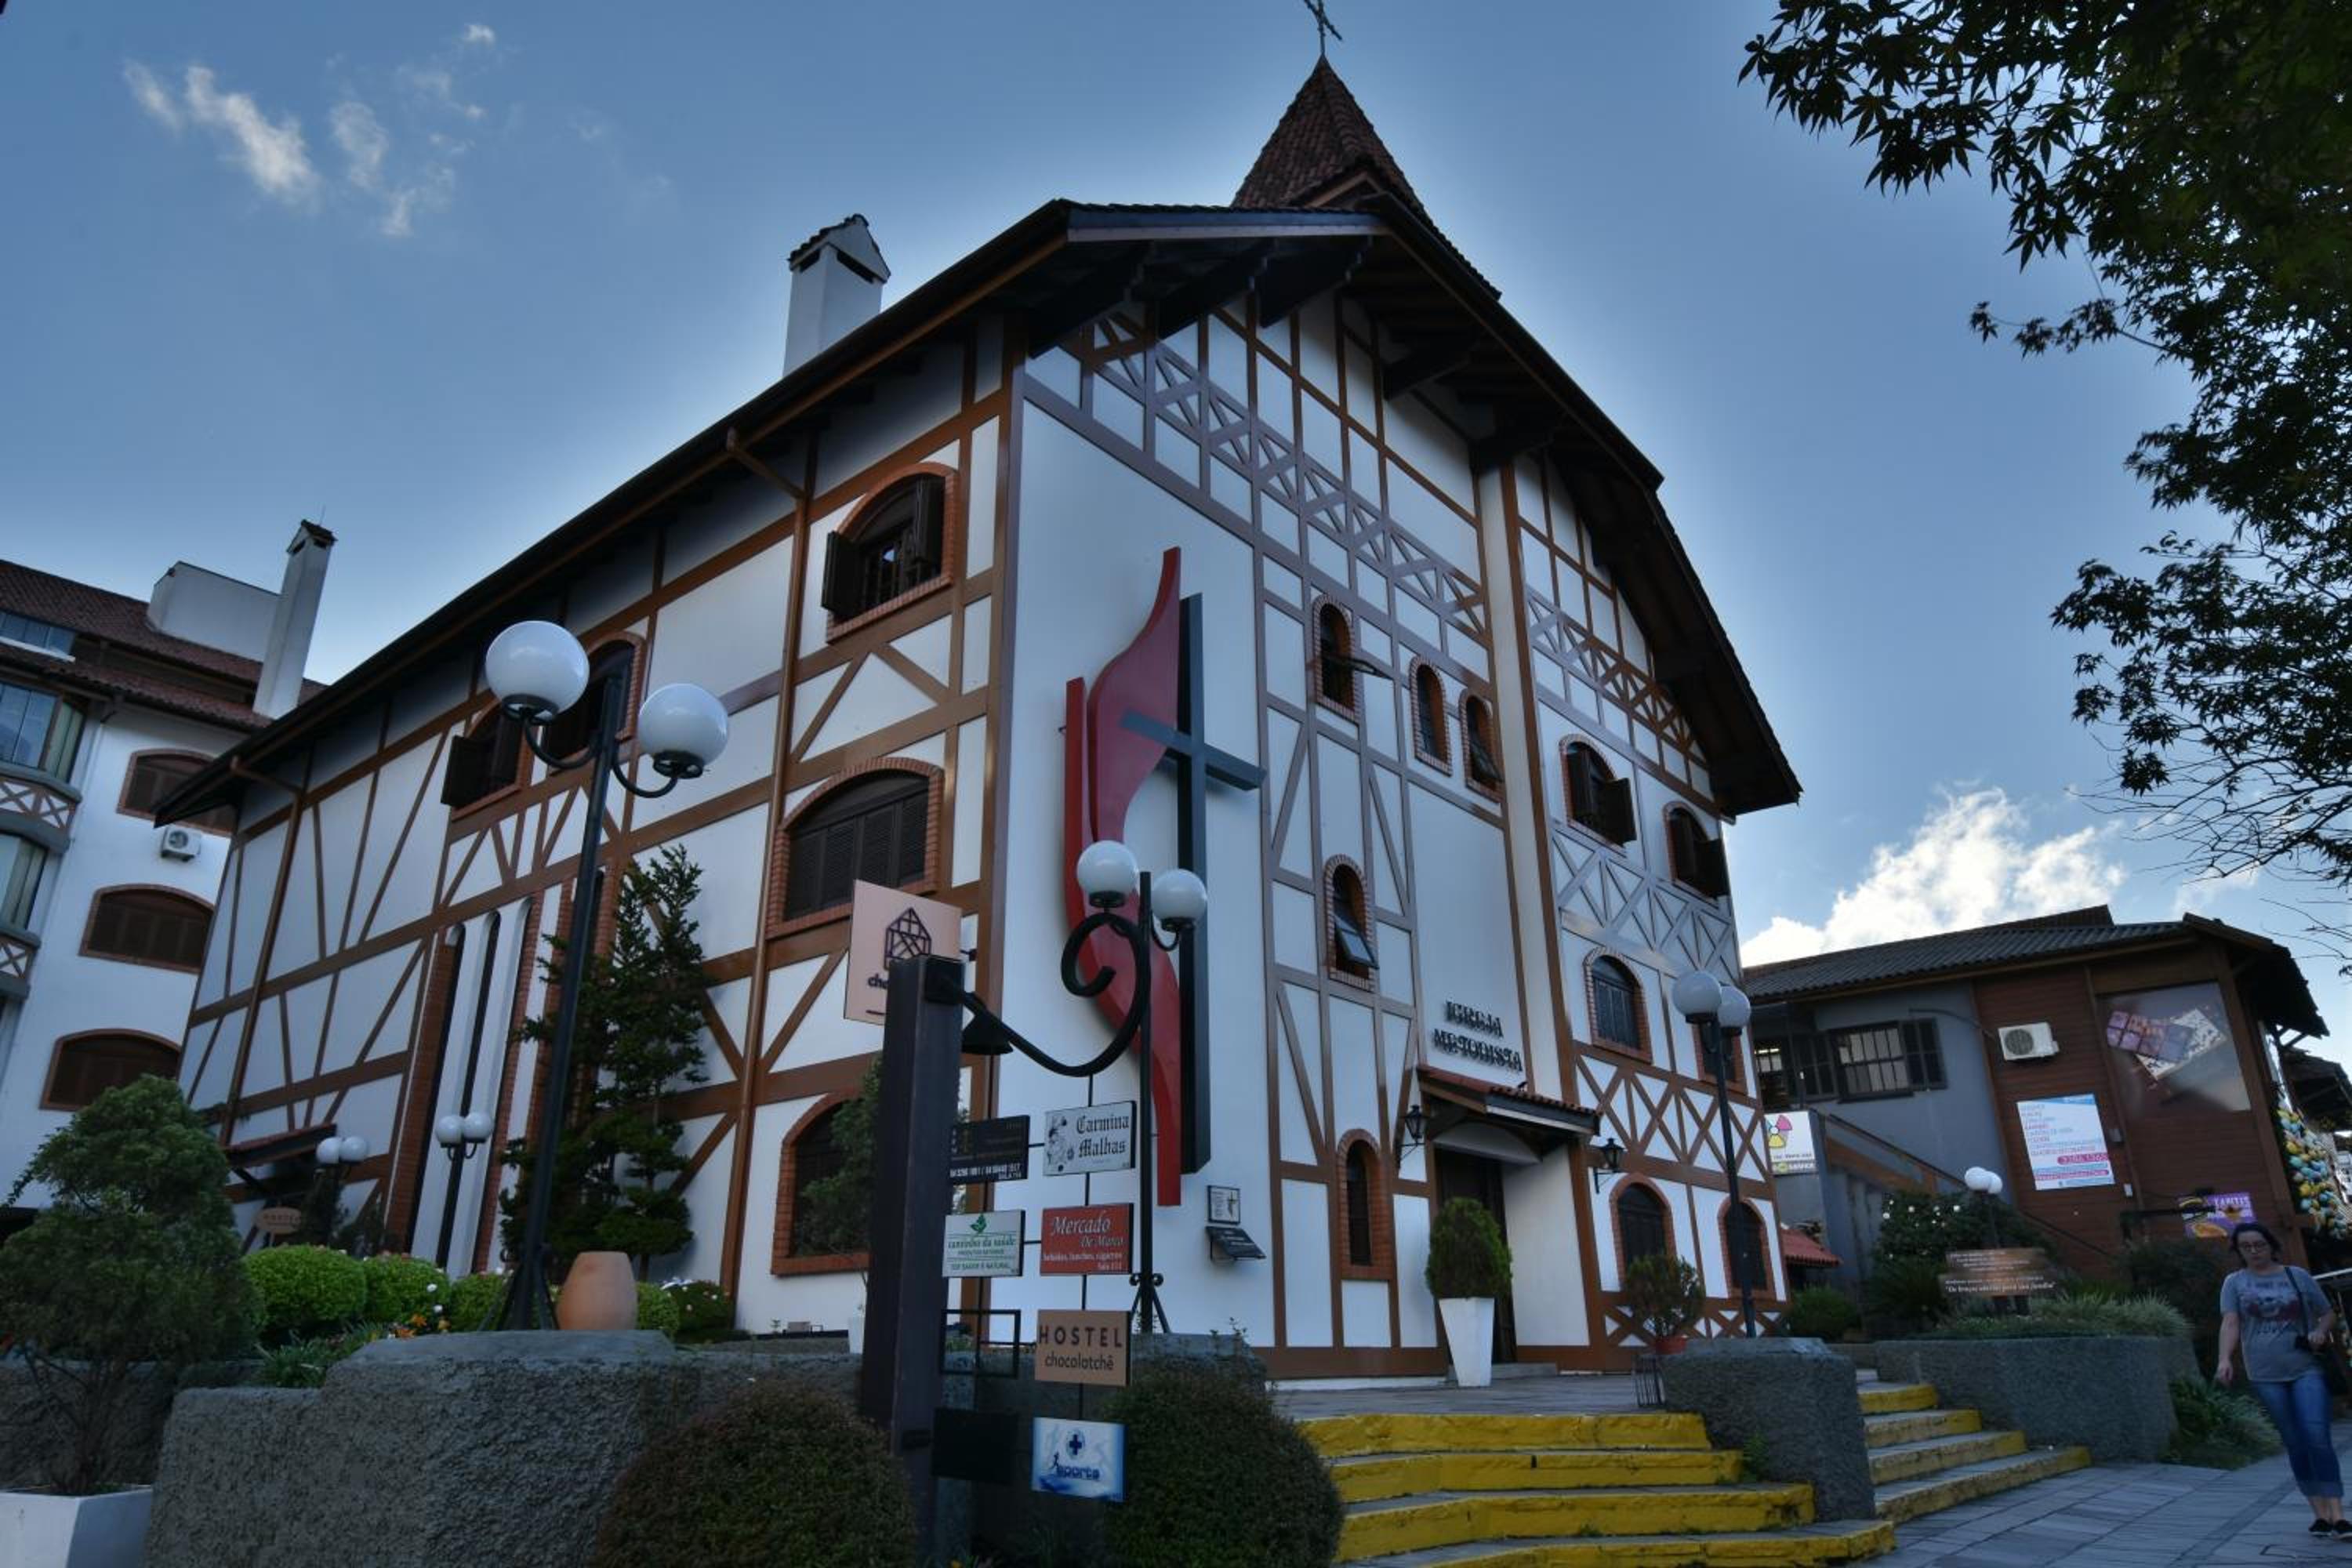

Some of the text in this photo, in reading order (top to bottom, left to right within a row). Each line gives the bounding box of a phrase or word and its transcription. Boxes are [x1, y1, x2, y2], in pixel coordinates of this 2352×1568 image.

[1444, 1001, 1504, 1038] IGREJA
[1432, 1028, 1523, 1072] METODISTA
[1076, 1114, 1130, 1134] Carmina
[1079, 1136, 1127, 1158] Malhas
[1051, 1210, 1111, 1236] Mercado
[1039, 1325, 1123, 1348] HOSTEL
